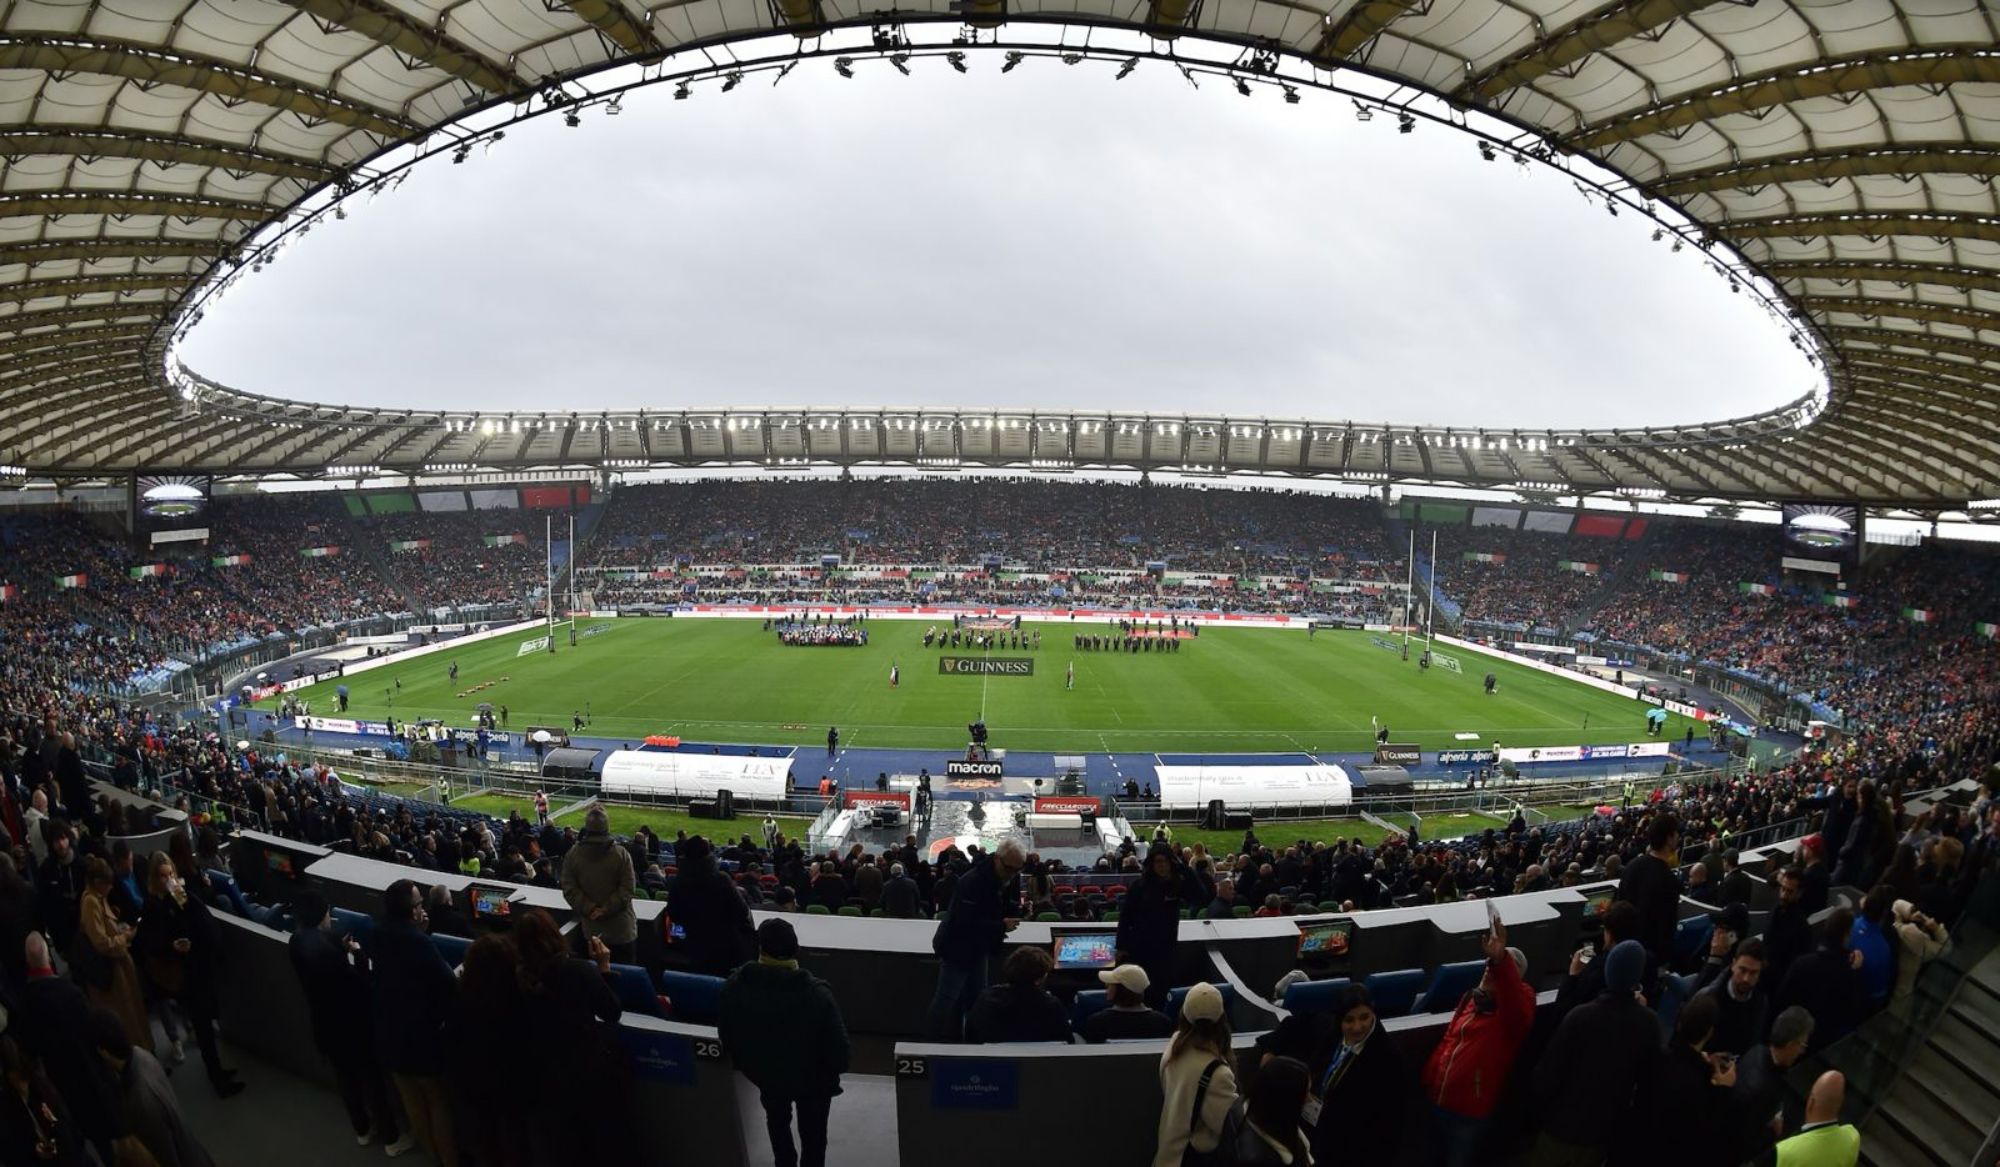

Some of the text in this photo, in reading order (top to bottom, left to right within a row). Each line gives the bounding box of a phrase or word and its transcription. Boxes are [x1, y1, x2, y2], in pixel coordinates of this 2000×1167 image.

[957, 660, 1029, 673] GUINNESS
[1388, 752, 1420, 760] GUINNESS
[949, 762, 1001, 776] macron
[696, 1042, 720, 1057] 26
[898, 1060, 925, 1074] 25
